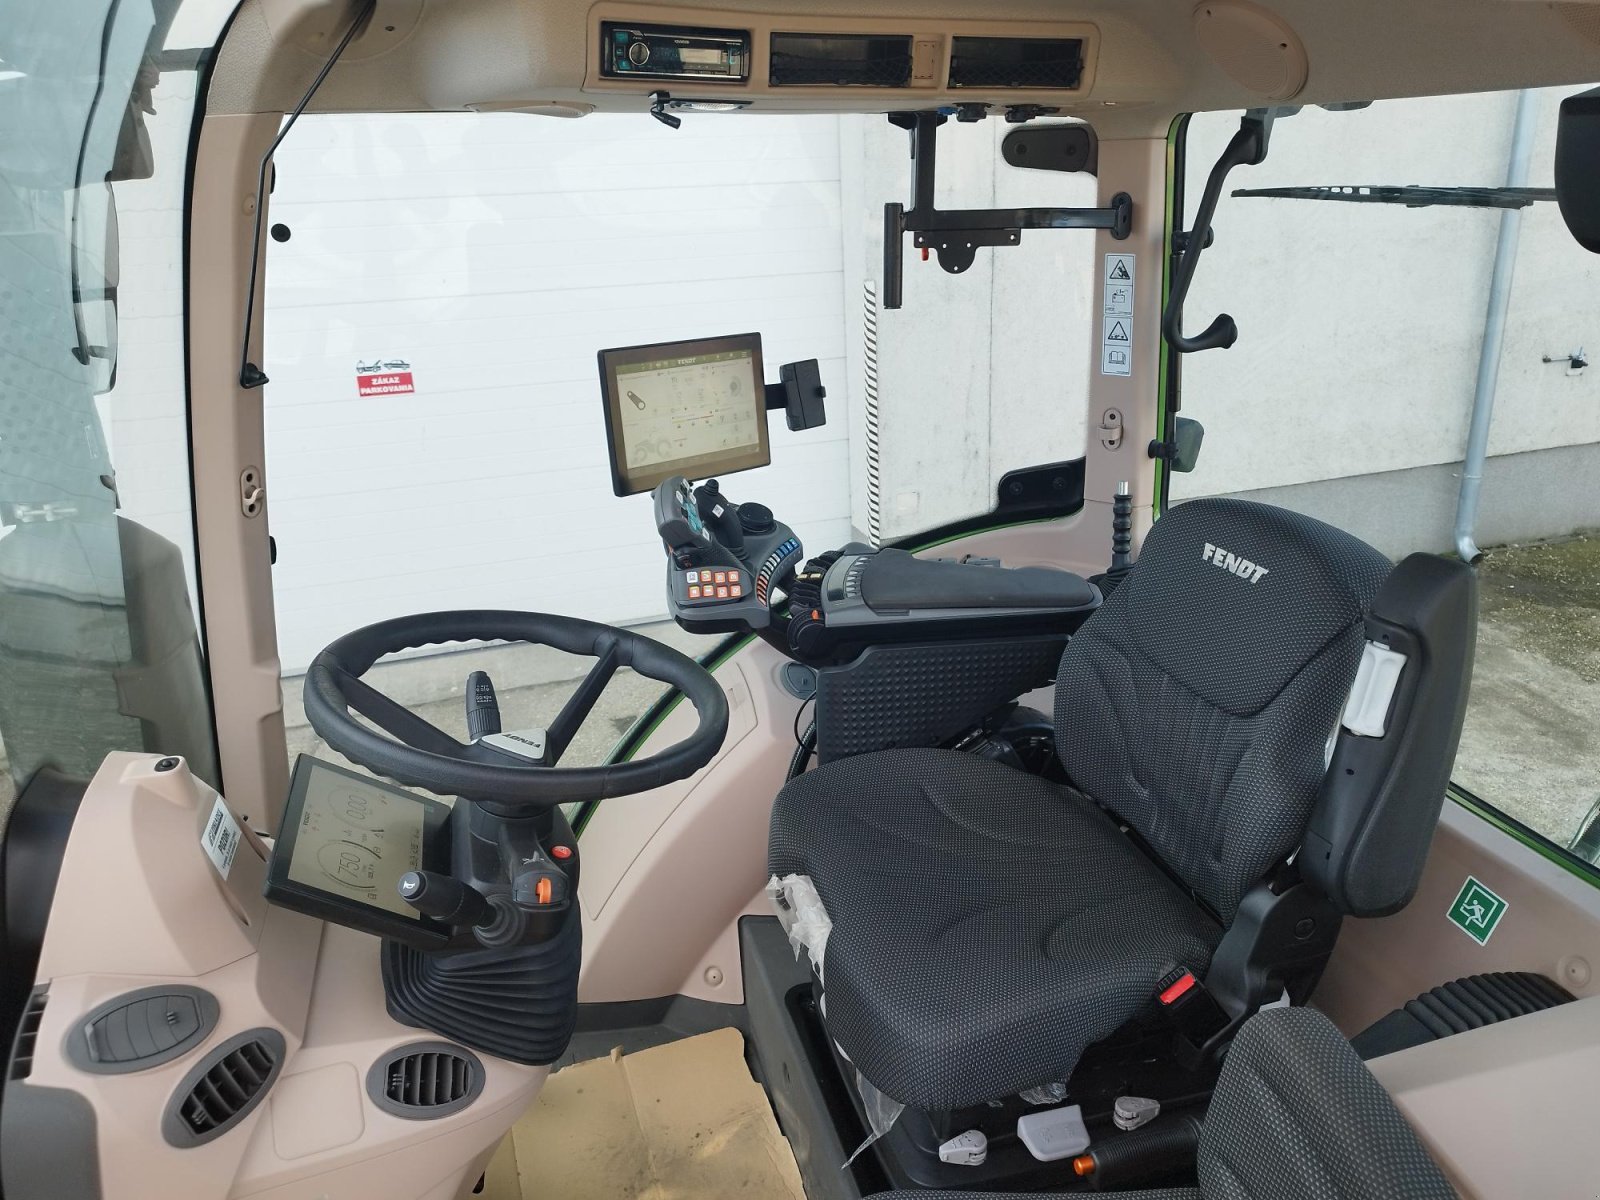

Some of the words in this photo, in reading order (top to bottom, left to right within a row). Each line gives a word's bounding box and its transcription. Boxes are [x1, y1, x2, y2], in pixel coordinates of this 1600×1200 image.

[371, 377, 401, 386] ZÁKAZ
[360, 384, 413, 395] PARKOVANIA
[1202, 543, 1269, 584] FENDT
[503, 733, 541, 748] FENDT
[338, 852, 360, 878] 750
